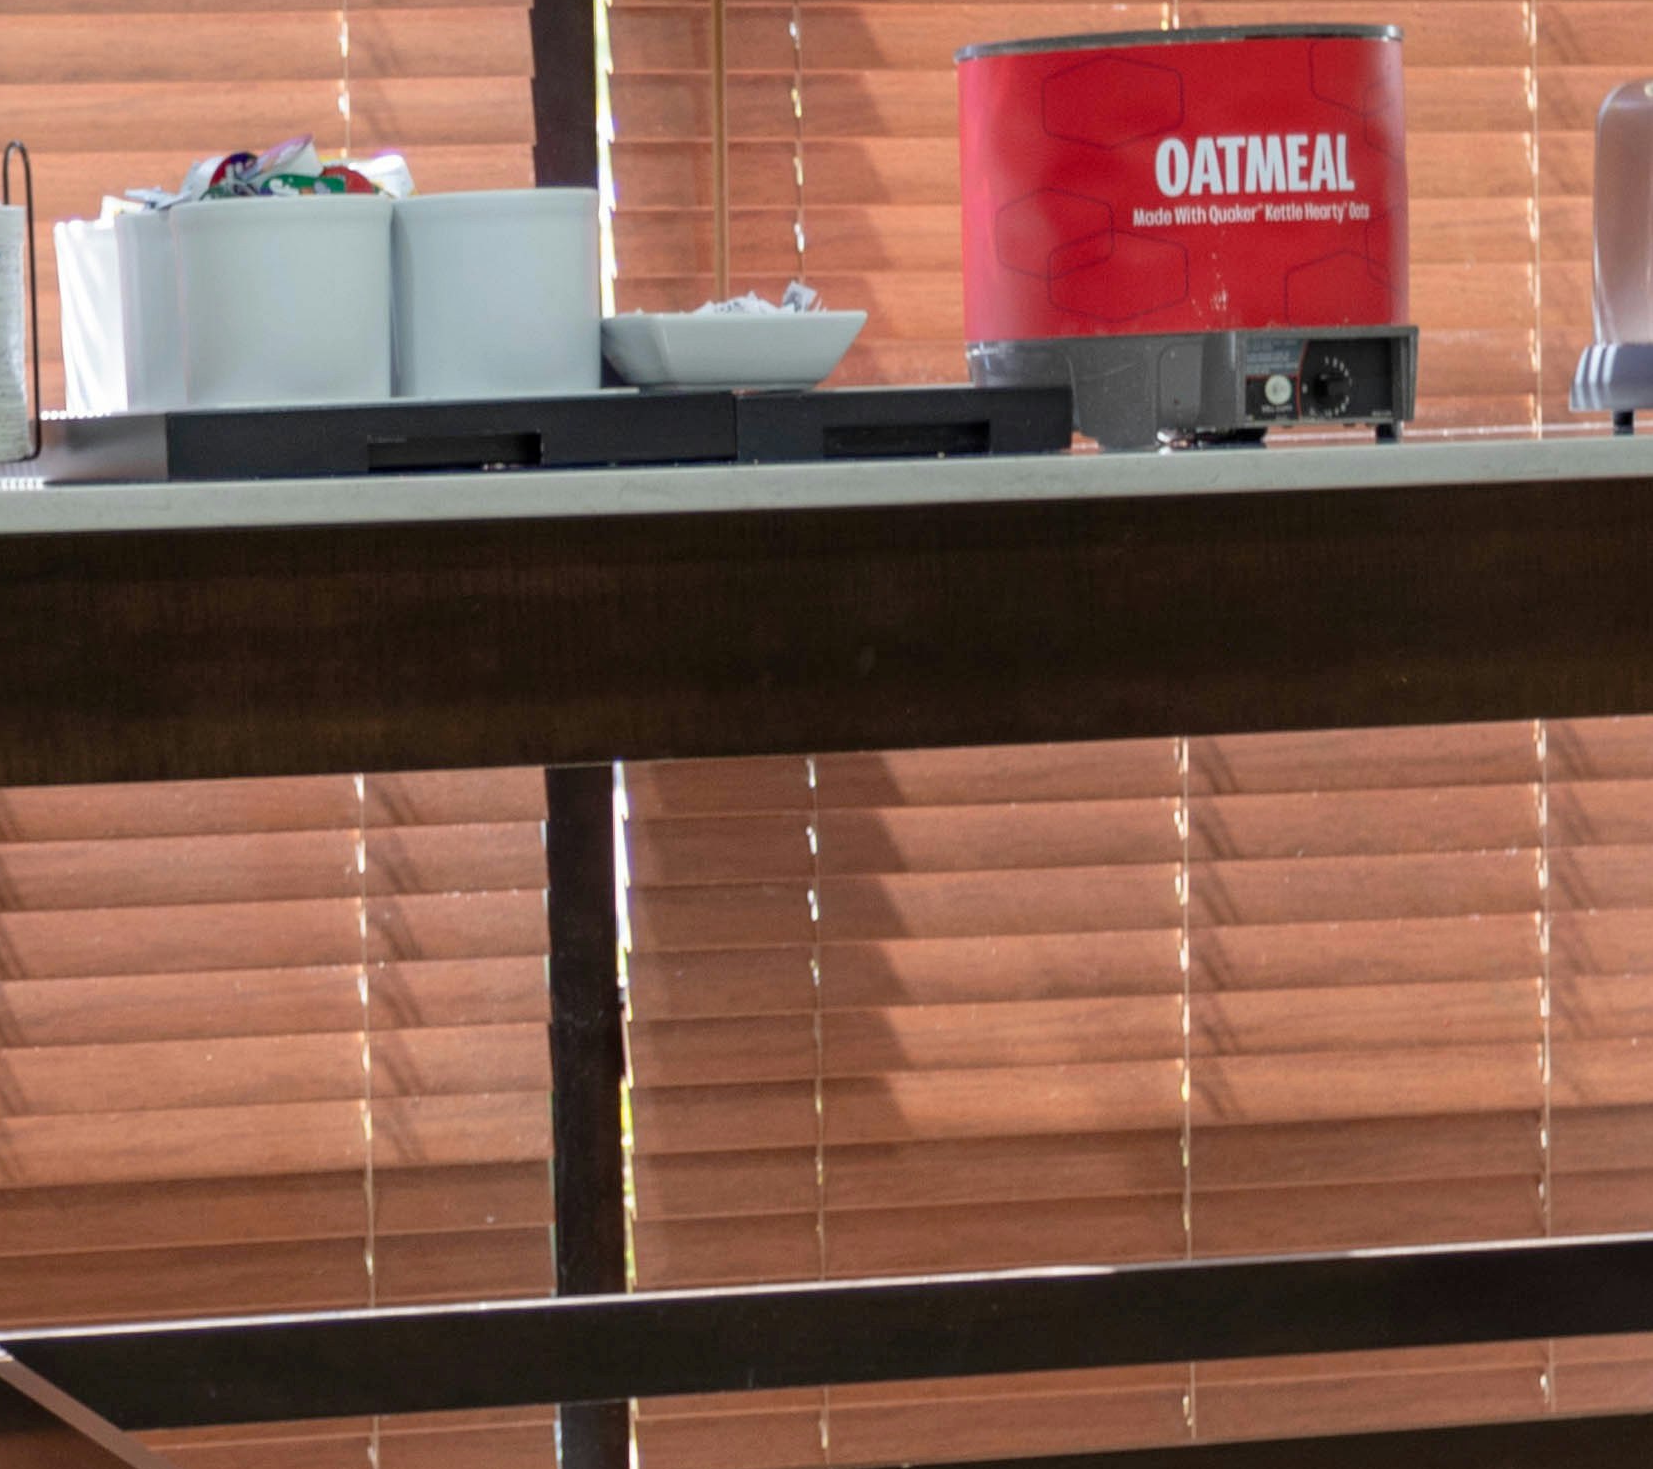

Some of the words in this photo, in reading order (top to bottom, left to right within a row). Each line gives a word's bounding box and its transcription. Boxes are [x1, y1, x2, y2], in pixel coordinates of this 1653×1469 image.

[1155, 134, 1356, 198] OATMEAL
[1132, 208, 1172, 227] Made
[1174, 205, 1207, 225] With
[1265, 202, 1304, 221] Kettle
